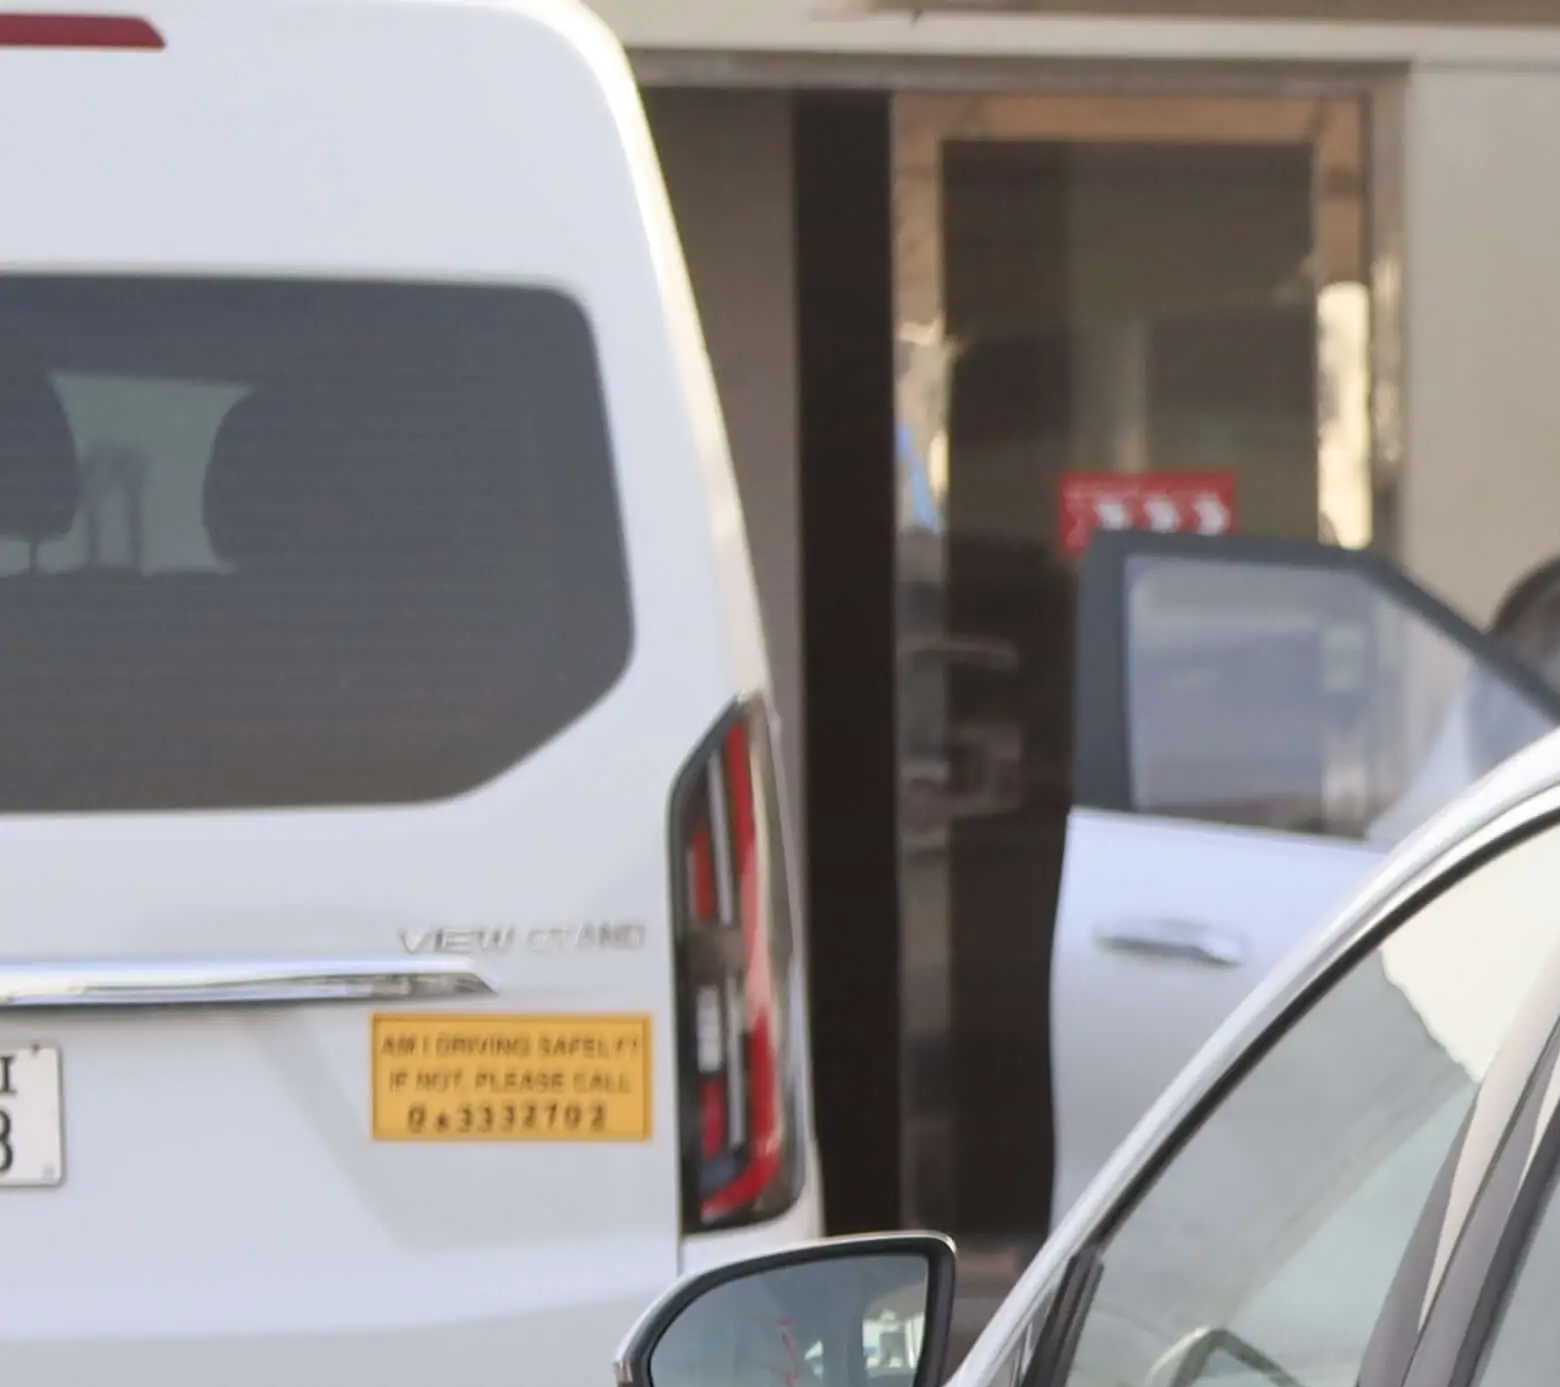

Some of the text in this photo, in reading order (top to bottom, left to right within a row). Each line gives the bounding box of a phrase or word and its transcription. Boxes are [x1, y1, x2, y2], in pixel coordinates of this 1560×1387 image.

[399, 925, 514, 954] VIEW
[435, 1031, 531, 1058] DRIVING
[389, 1066, 409, 1092] IF
[474, 1067, 565, 1094] PLEASE
[573, 1067, 632, 1094] CALL
